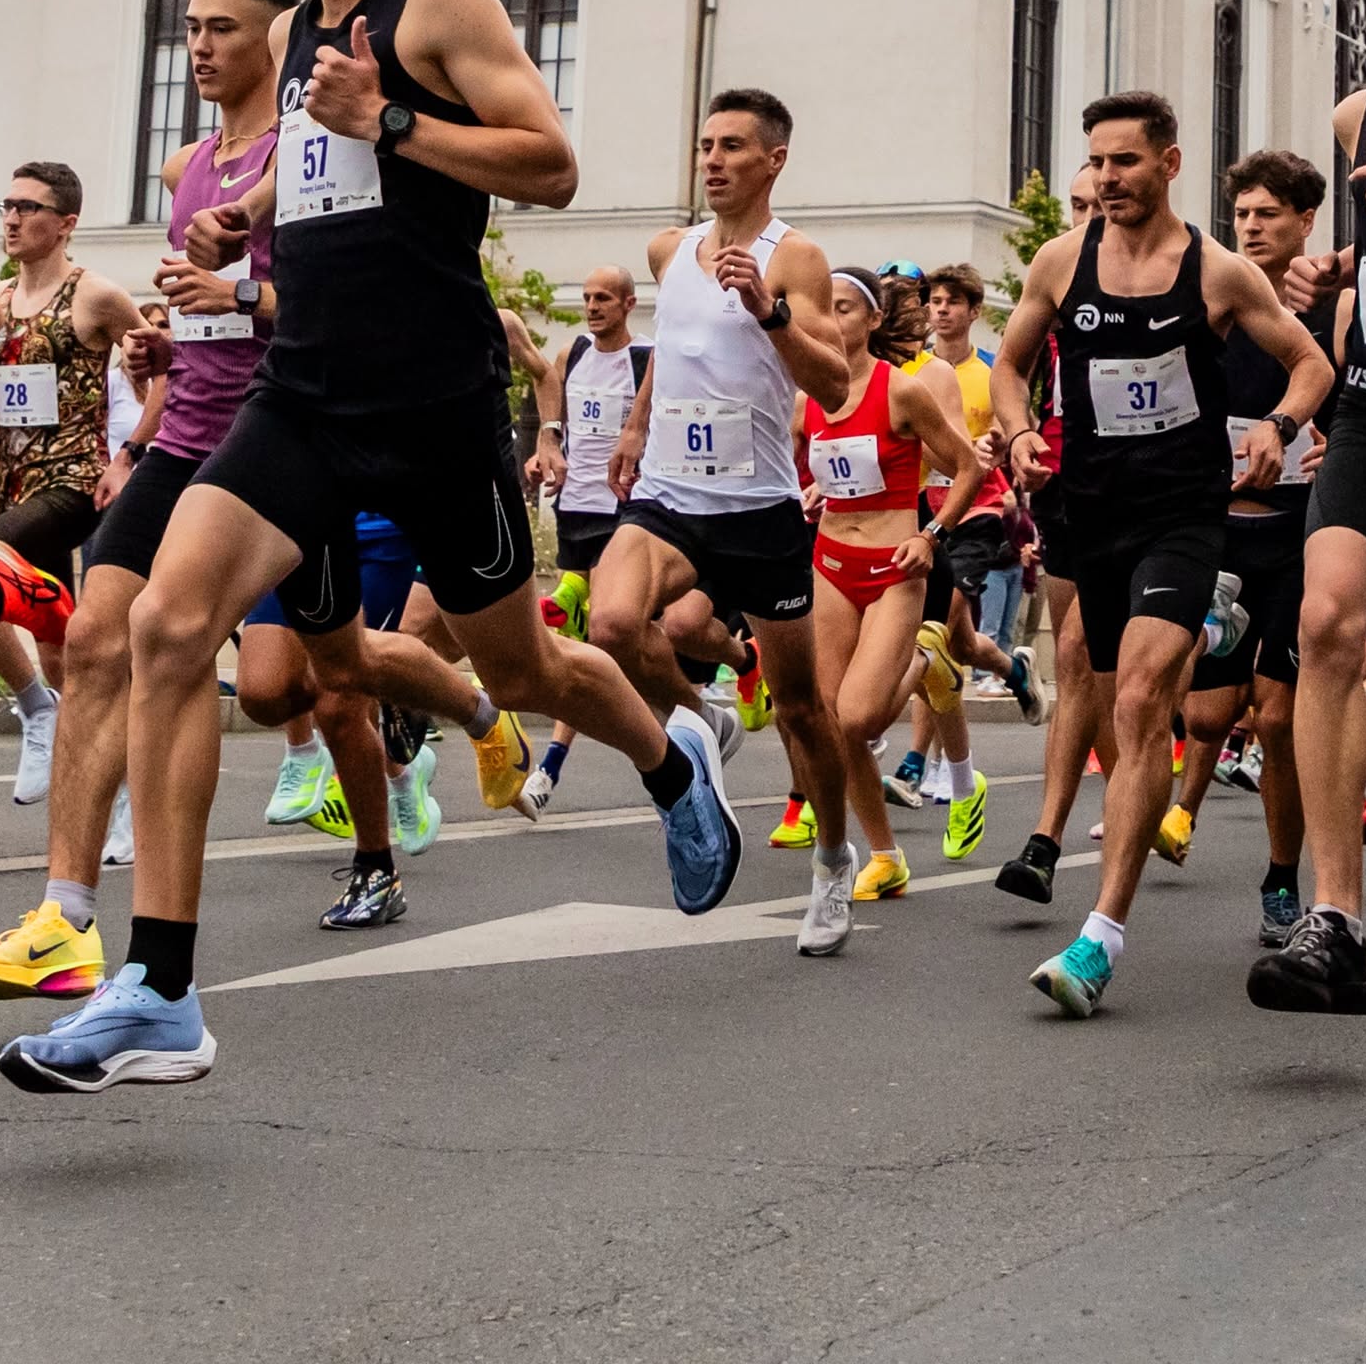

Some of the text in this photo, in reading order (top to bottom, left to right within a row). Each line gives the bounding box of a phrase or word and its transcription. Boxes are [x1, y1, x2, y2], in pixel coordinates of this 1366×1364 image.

[303, 135, 328, 181] 57
[1104, 313, 1125, 323] NN
[5, 383, 28, 406] 28
[1127, 381, 1157, 410] 37
[582, 400, 601, 419] 36
[687, 423, 713, 452] 61
[828, 456, 851, 479] 10
[775, 594, 807, 610] FUGA
